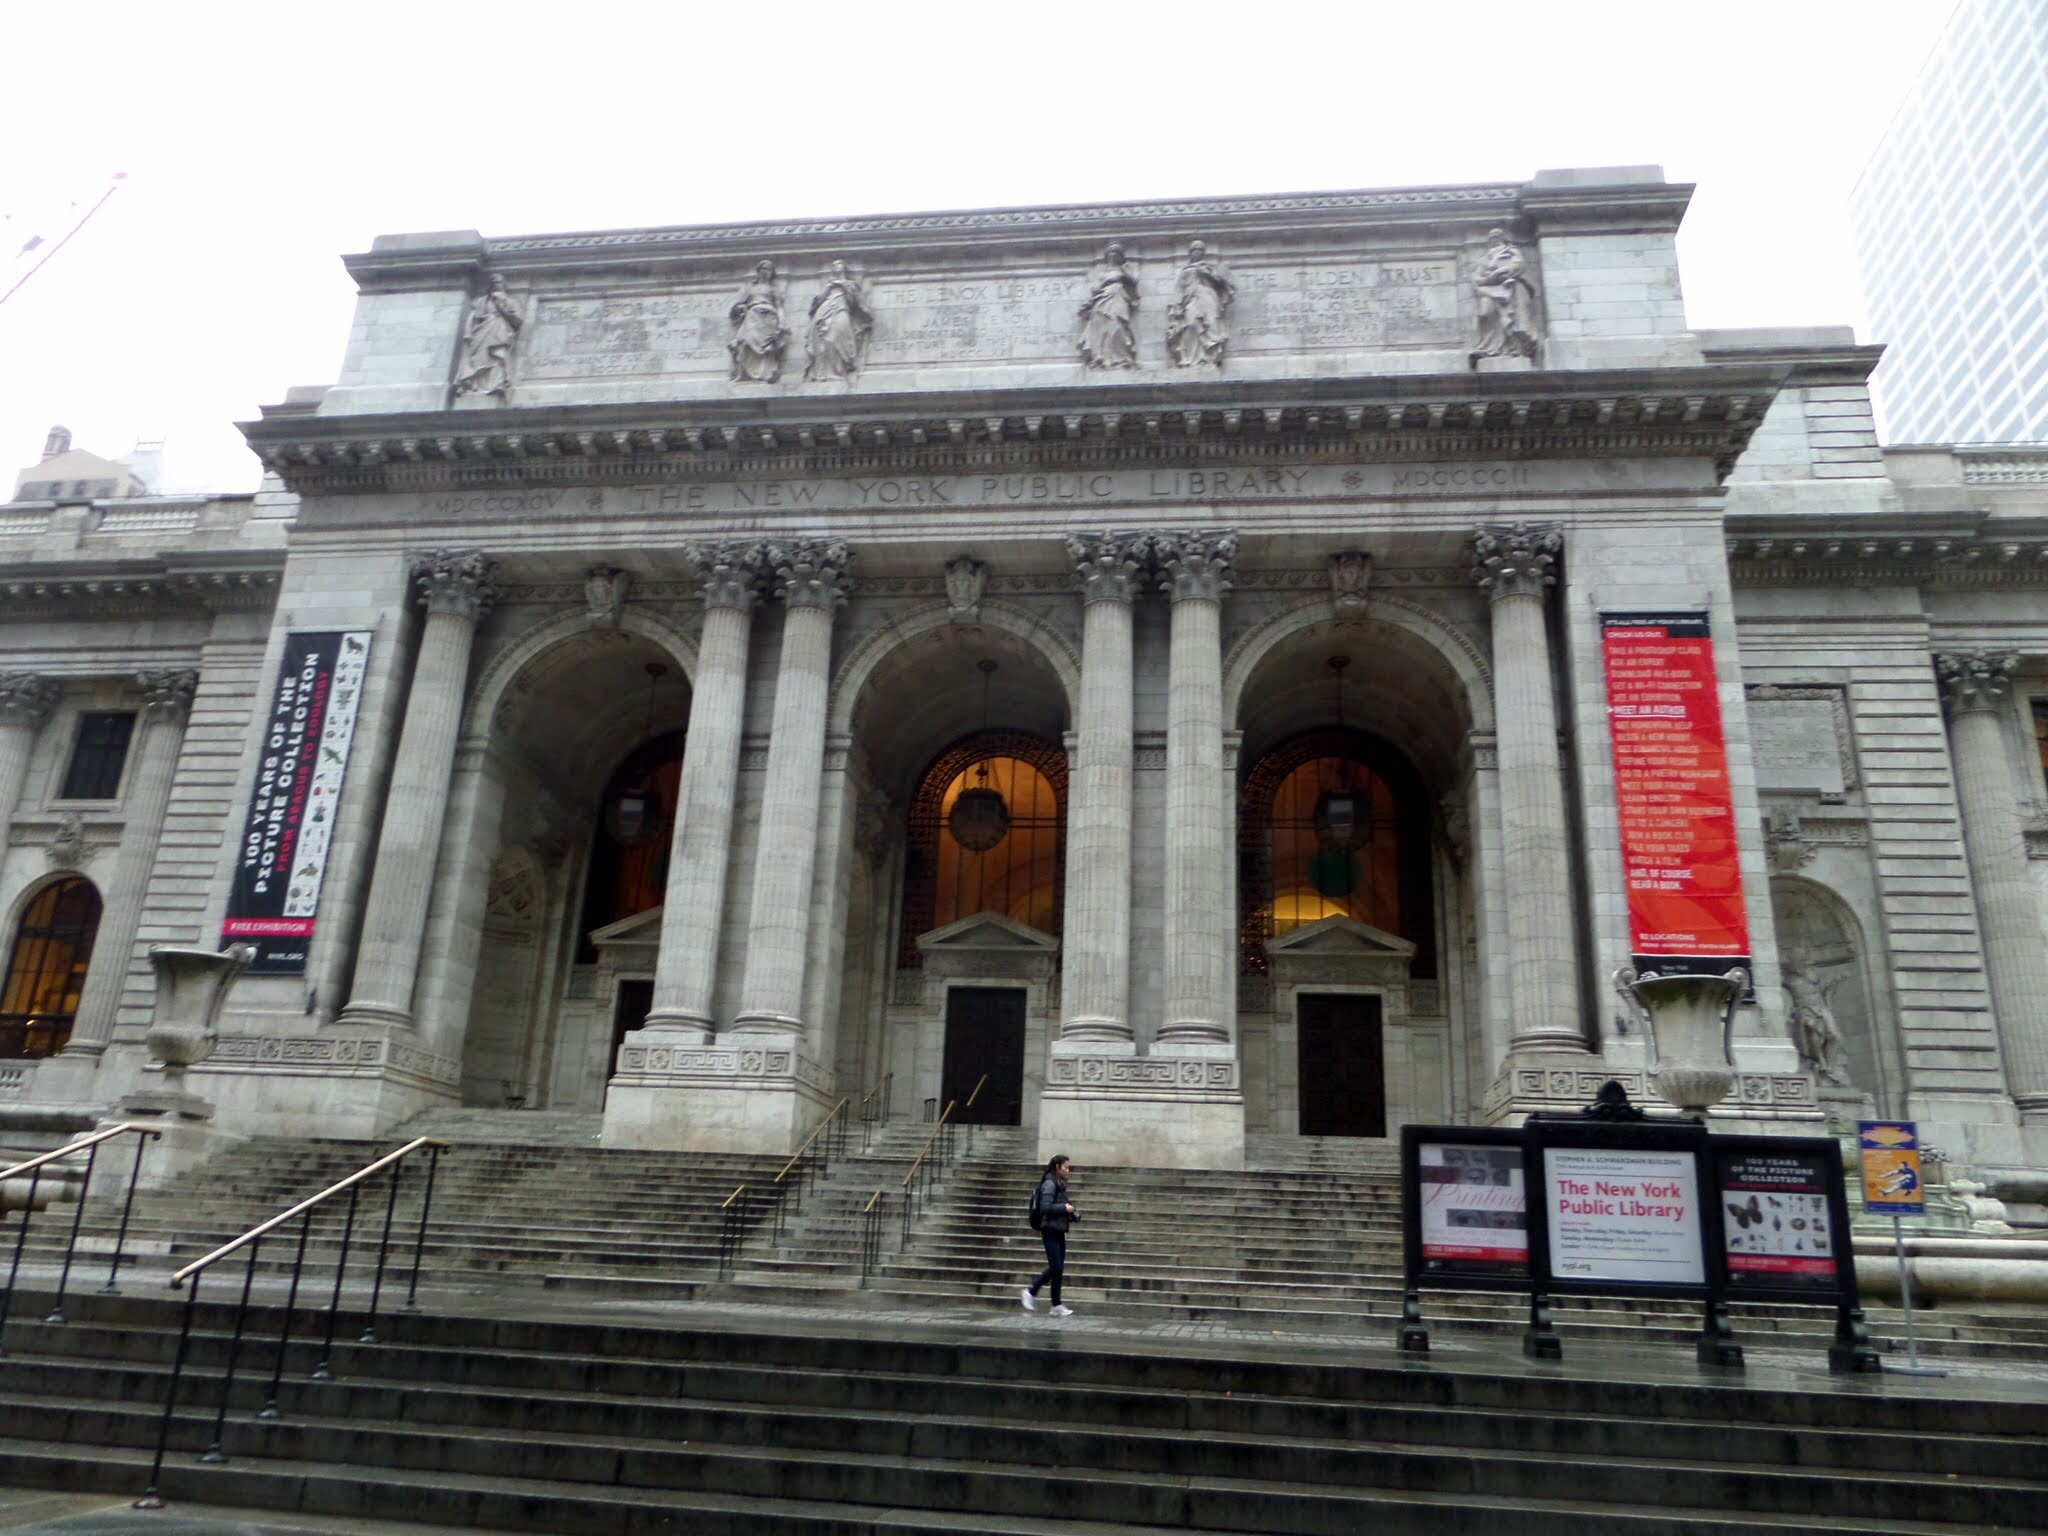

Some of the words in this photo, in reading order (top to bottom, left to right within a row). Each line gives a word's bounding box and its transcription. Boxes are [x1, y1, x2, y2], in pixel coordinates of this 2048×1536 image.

[1240, 273, 1278, 290] THE
[1294, 270, 1364, 287] TILDEN
[1381, 266, 1445, 283] TRUST
[883, 289, 919, 304] THE
[927, 286, 988, 303] LENOX
[997, 282, 1076, 300] LIBRARY
[635, 486, 705, 511] THE
[734, 481, 824, 507] NEW
[855, 478, 951, 504] YORK
[980, 474, 1113, 501] PUBLIC
[1150, 469, 1310, 497] LIBRARY
[1392, 467, 1529, 487] MDCCCCII
[277, 676, 297, 716] THE
[269, 722, 287, 749] OF
[254, 795, 289, 893] PICTURE
[277, 652, 320, 788] COLLECTION
[252, 755, 279, 825] YEARS
[244, 832, 262, 868] 100
[253, 922, 306, 932] EXHIBITION
[1740, 1174, 1807, 1183] COLLECTION
[1769, 1167, 1814, 1175] PICTURE
[1557, 1180, 1589, 1195] The
[1595, 1181, 1636, 1197] New
[1641, 1182, 1681, 1198] York
[1559, 1199, 1615, 1216] Public
[1619, 1201, 1685, 1222] Library
